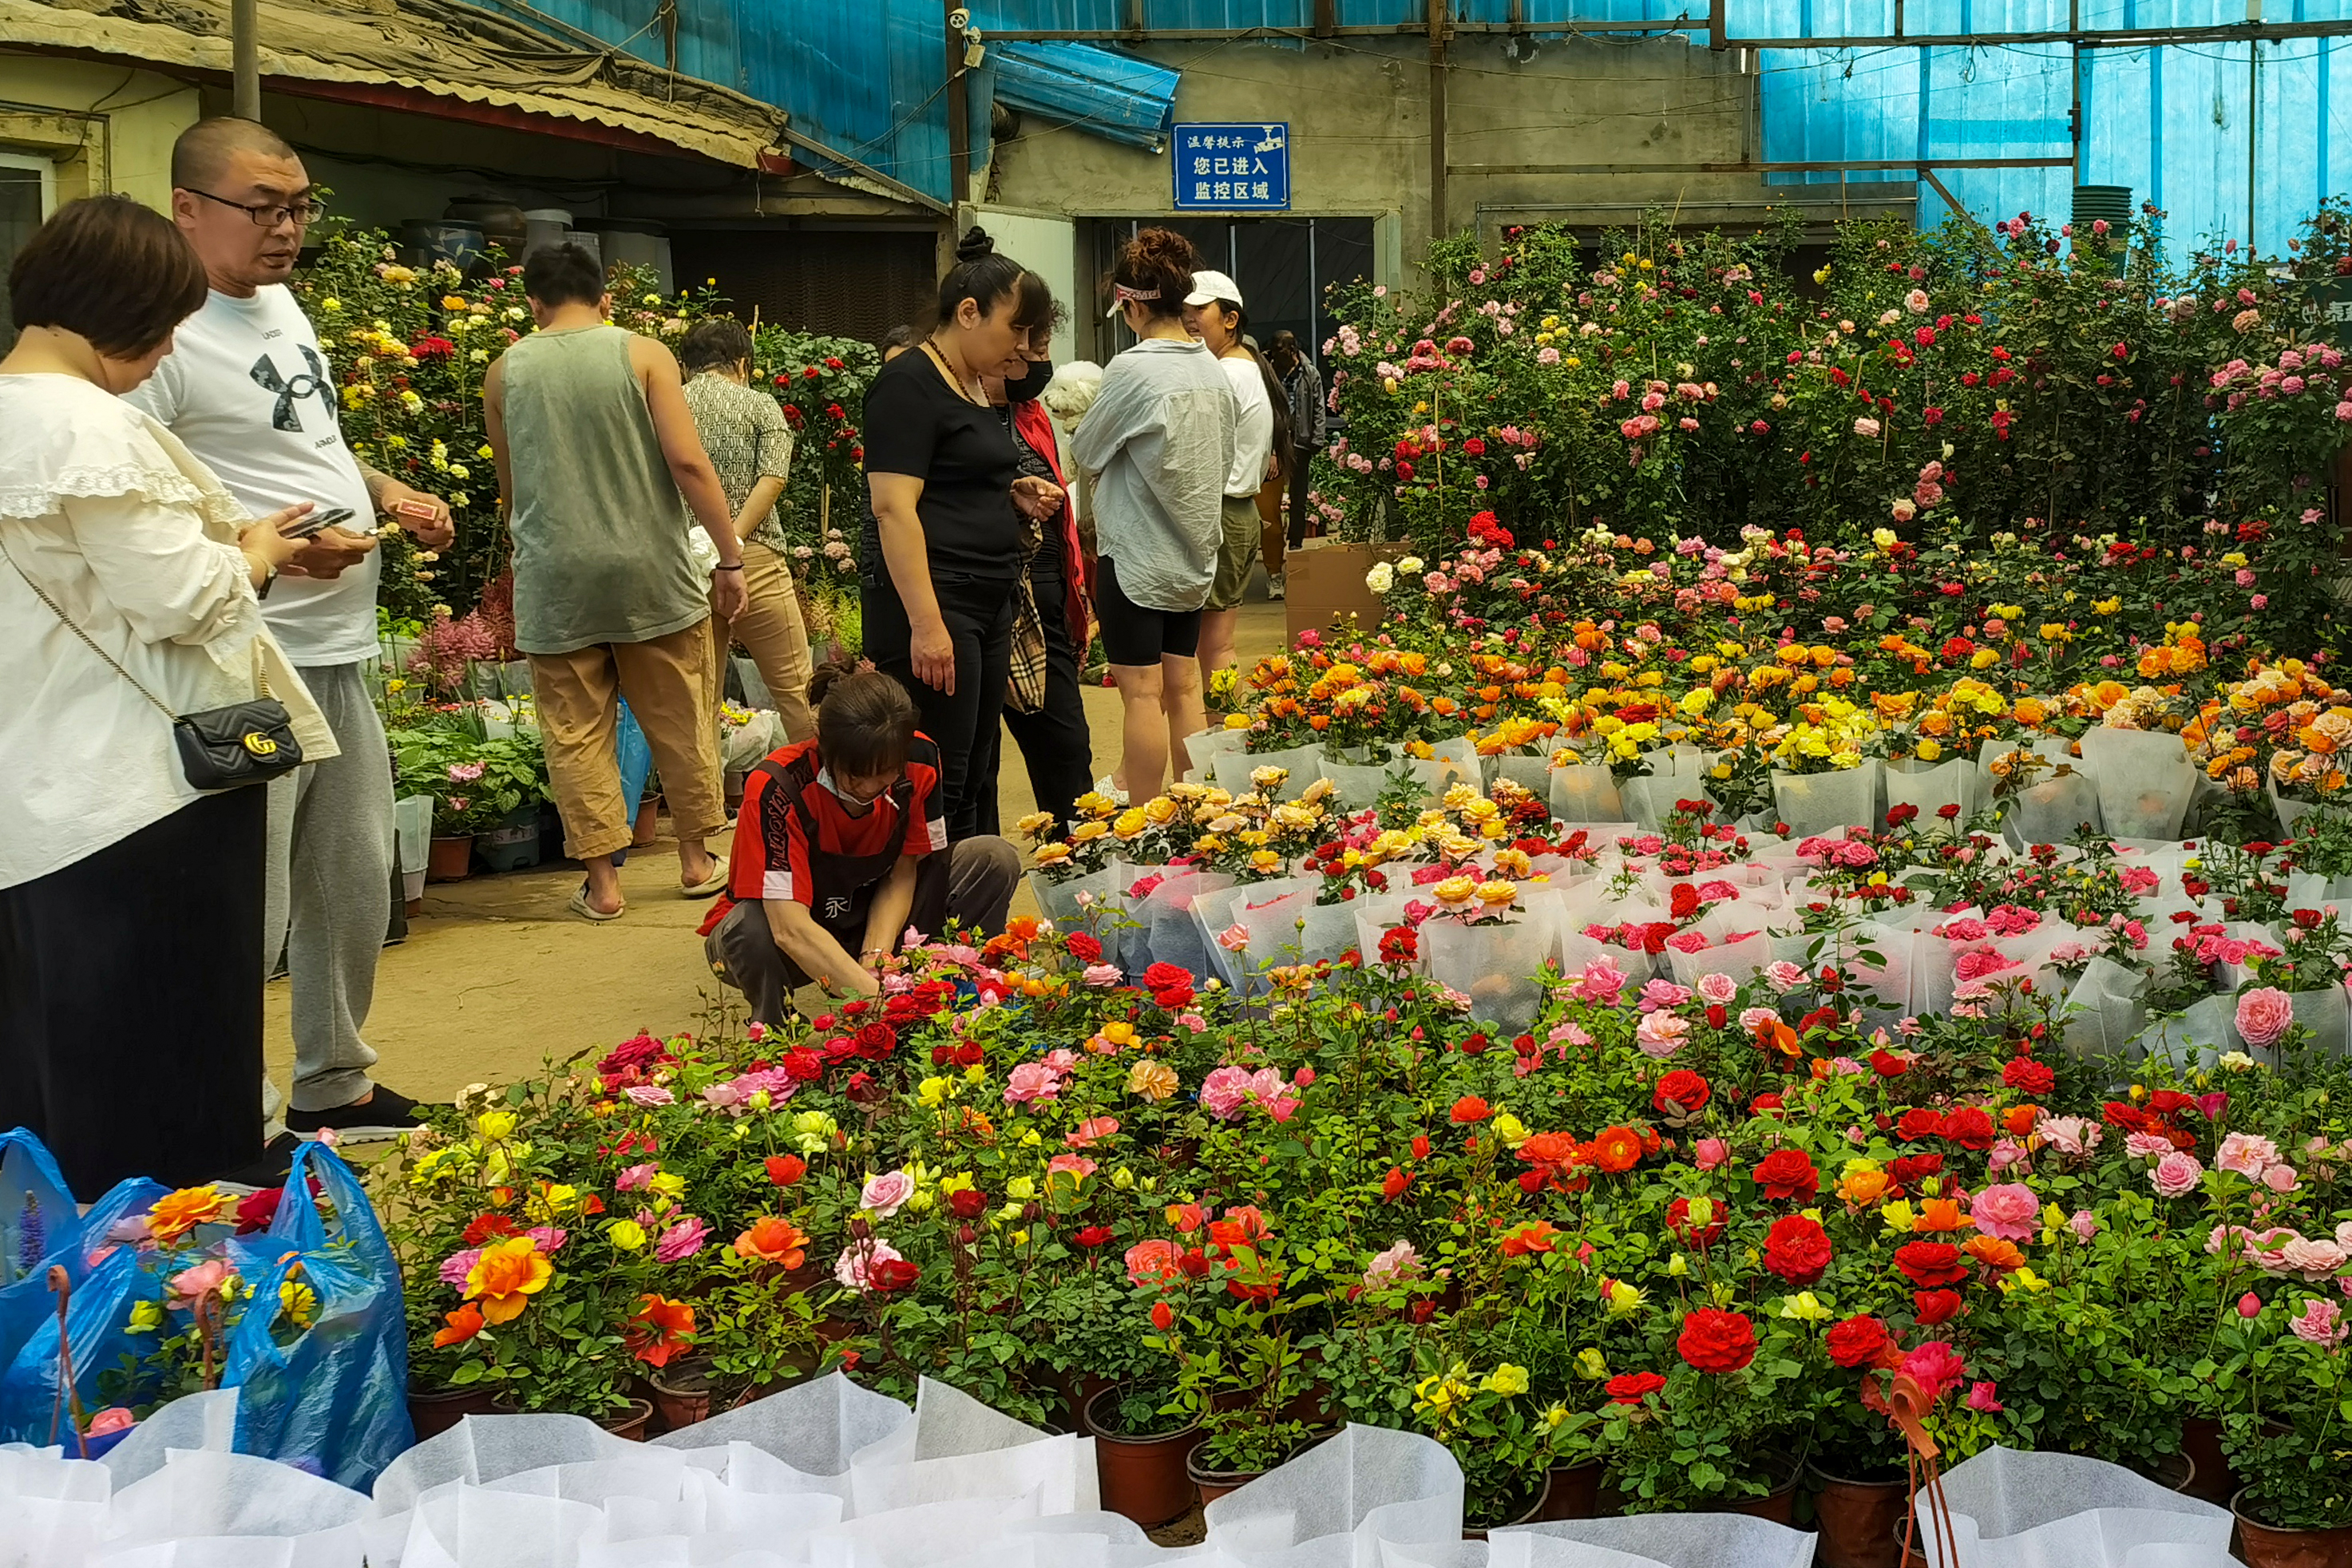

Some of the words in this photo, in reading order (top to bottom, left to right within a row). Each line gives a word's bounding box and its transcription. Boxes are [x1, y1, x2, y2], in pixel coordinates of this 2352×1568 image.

[1187, 136, 1245, 150] 温馨提示
[1194, 156, 1269, 176] 您已进入
[1194, 181, 1270, 200] 监控区域
[315, 435, 337, 449] ARMOU
